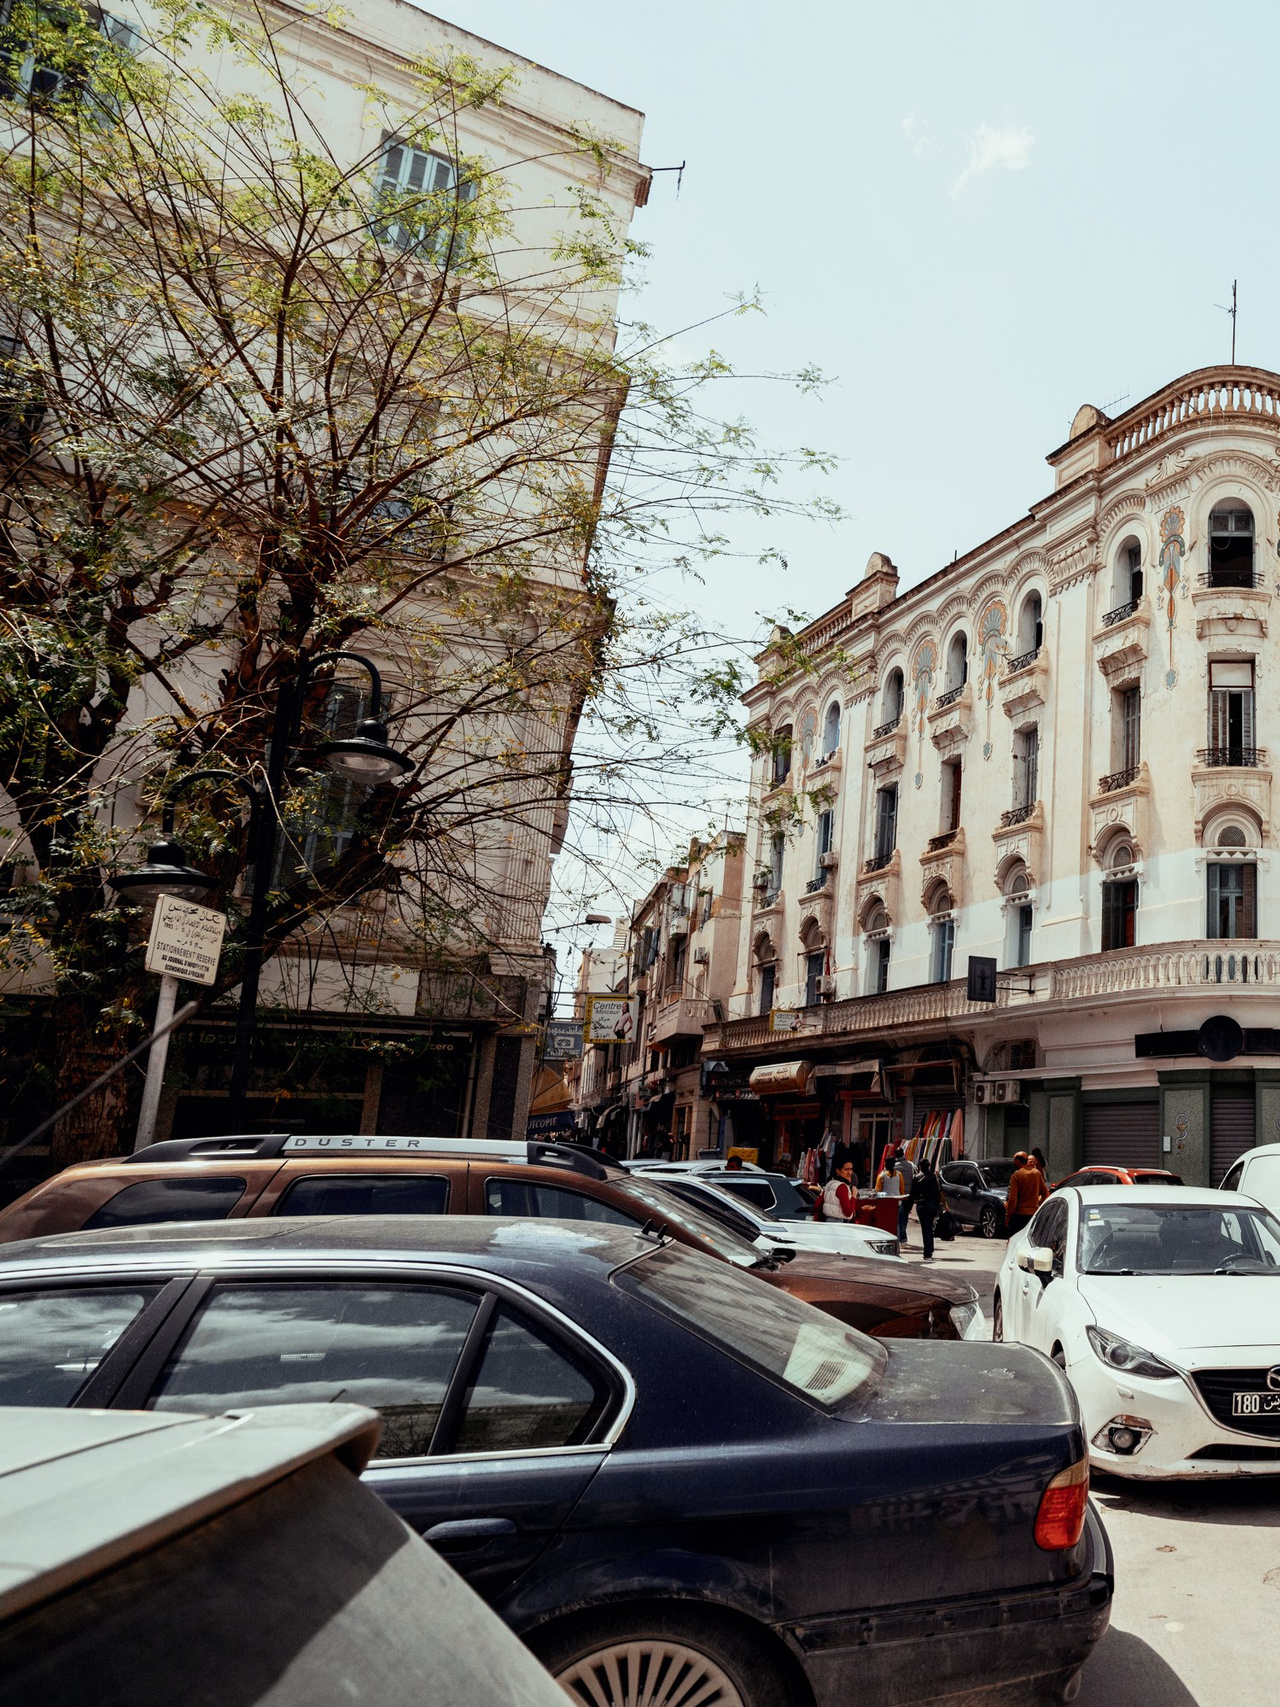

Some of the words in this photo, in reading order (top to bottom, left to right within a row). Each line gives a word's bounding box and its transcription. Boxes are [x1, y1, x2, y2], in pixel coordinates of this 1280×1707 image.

[593, 1001, 622, 1010] Centre
[294, 1138, 420, 1148] DUSTER
[1236, 1394, 1260, 1414] 180
